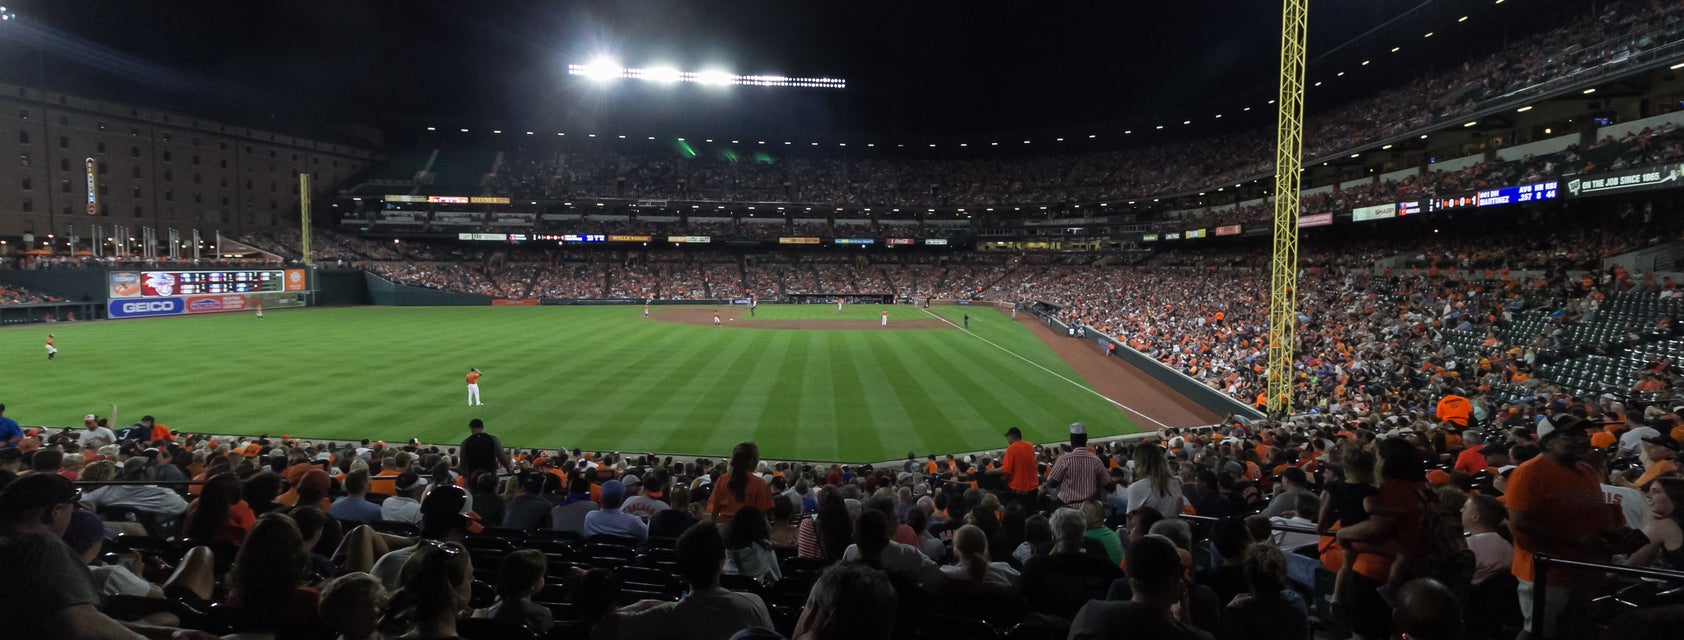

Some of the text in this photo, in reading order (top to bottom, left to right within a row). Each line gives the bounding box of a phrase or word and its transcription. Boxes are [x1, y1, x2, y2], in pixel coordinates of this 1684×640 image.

[1545, 182, 1558, 190] RBI
[1582, 181, 1592, 190] ON
[1592, 179, 1605, 188] THE
[1605, 177, 1619, 187] JOB
[1620, 175, 1641, 185] SINCE
[1479, 196, 1510, 206] MARTINEZ
[1545, 190, 1556, 198] 44
[1375, 207, 1395, 216] SHARP
[122, 301, 174, 313] GEICO
[119, 429, 131, 440] 3
